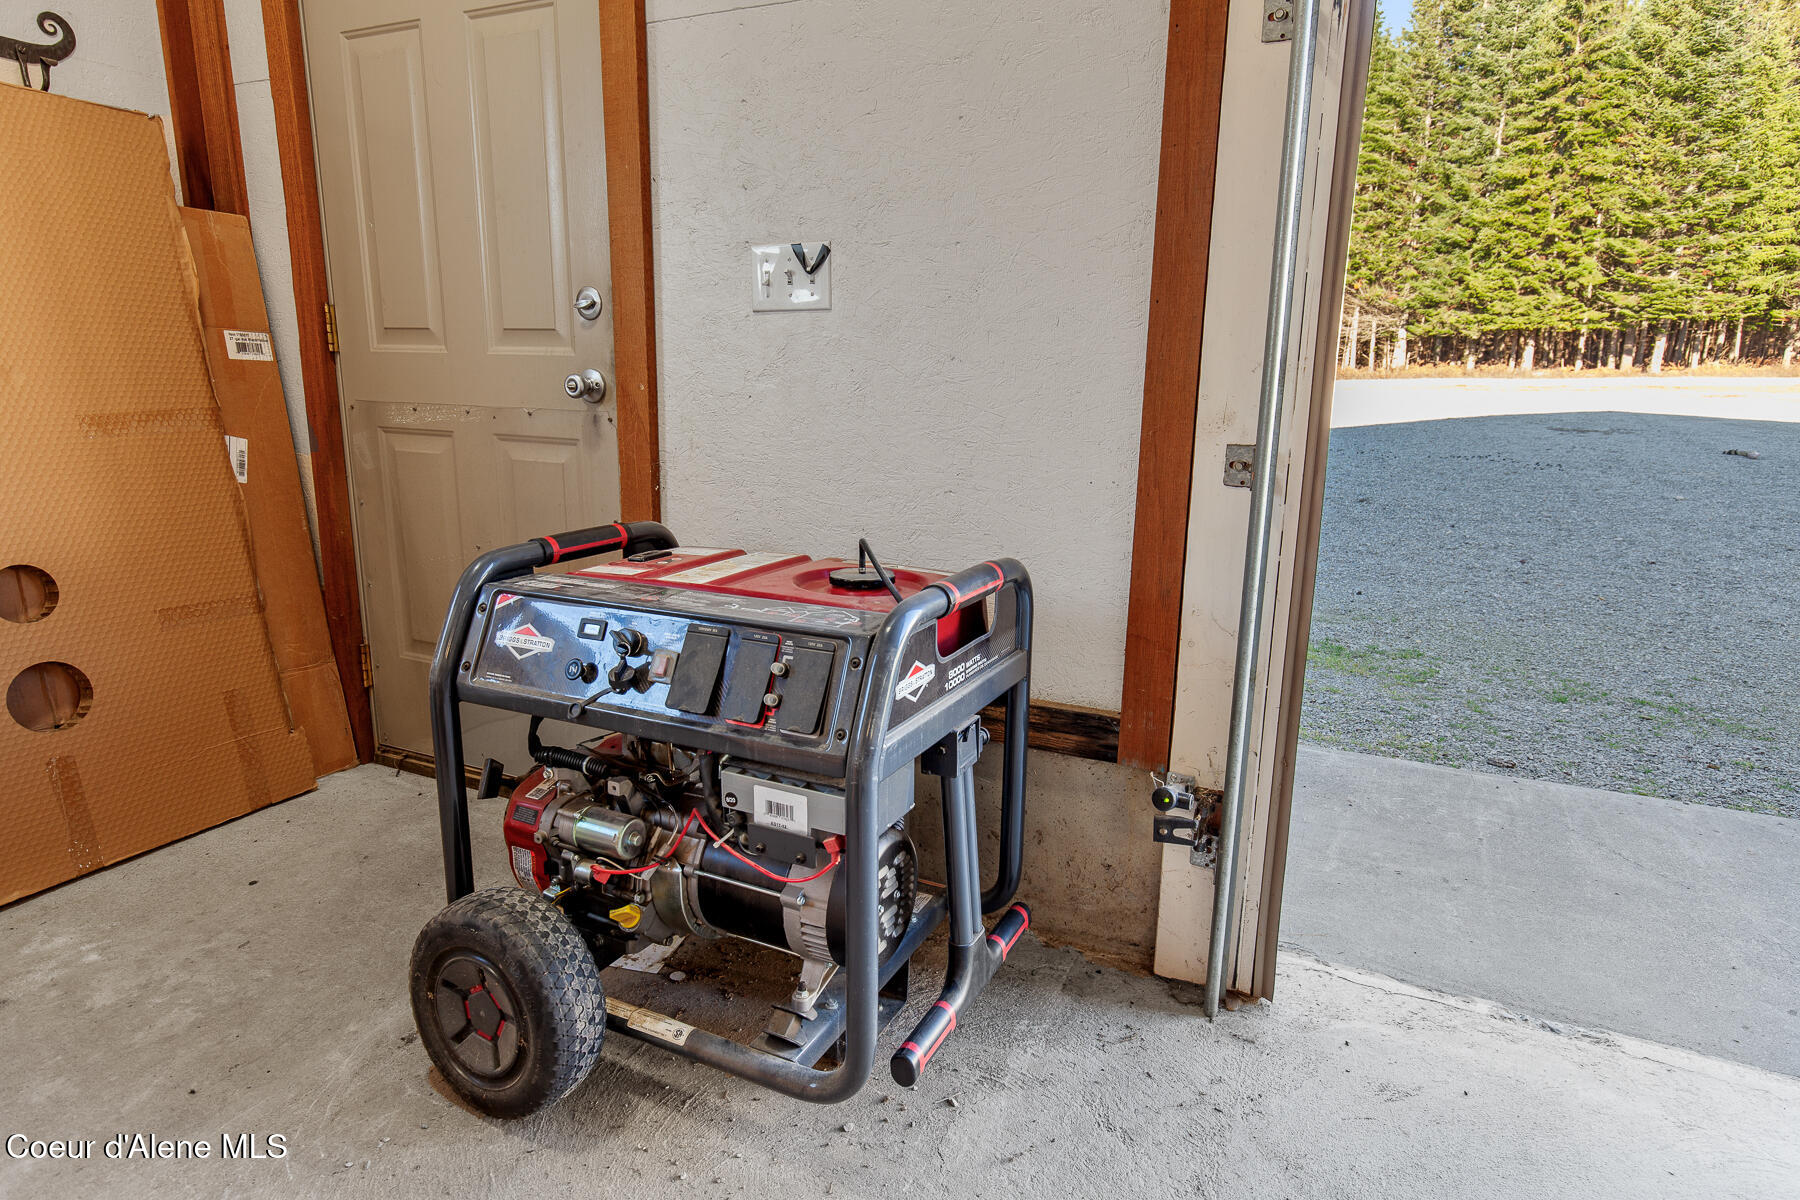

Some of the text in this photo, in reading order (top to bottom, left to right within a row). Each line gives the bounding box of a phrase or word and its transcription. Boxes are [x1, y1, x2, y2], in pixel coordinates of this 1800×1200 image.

[500, 634, 520, 644] BGGS
[523, 638, 551, 649] STRATTON
[948, 662, 966, 680] 8000
[944, 672, 966, 691] 10000
